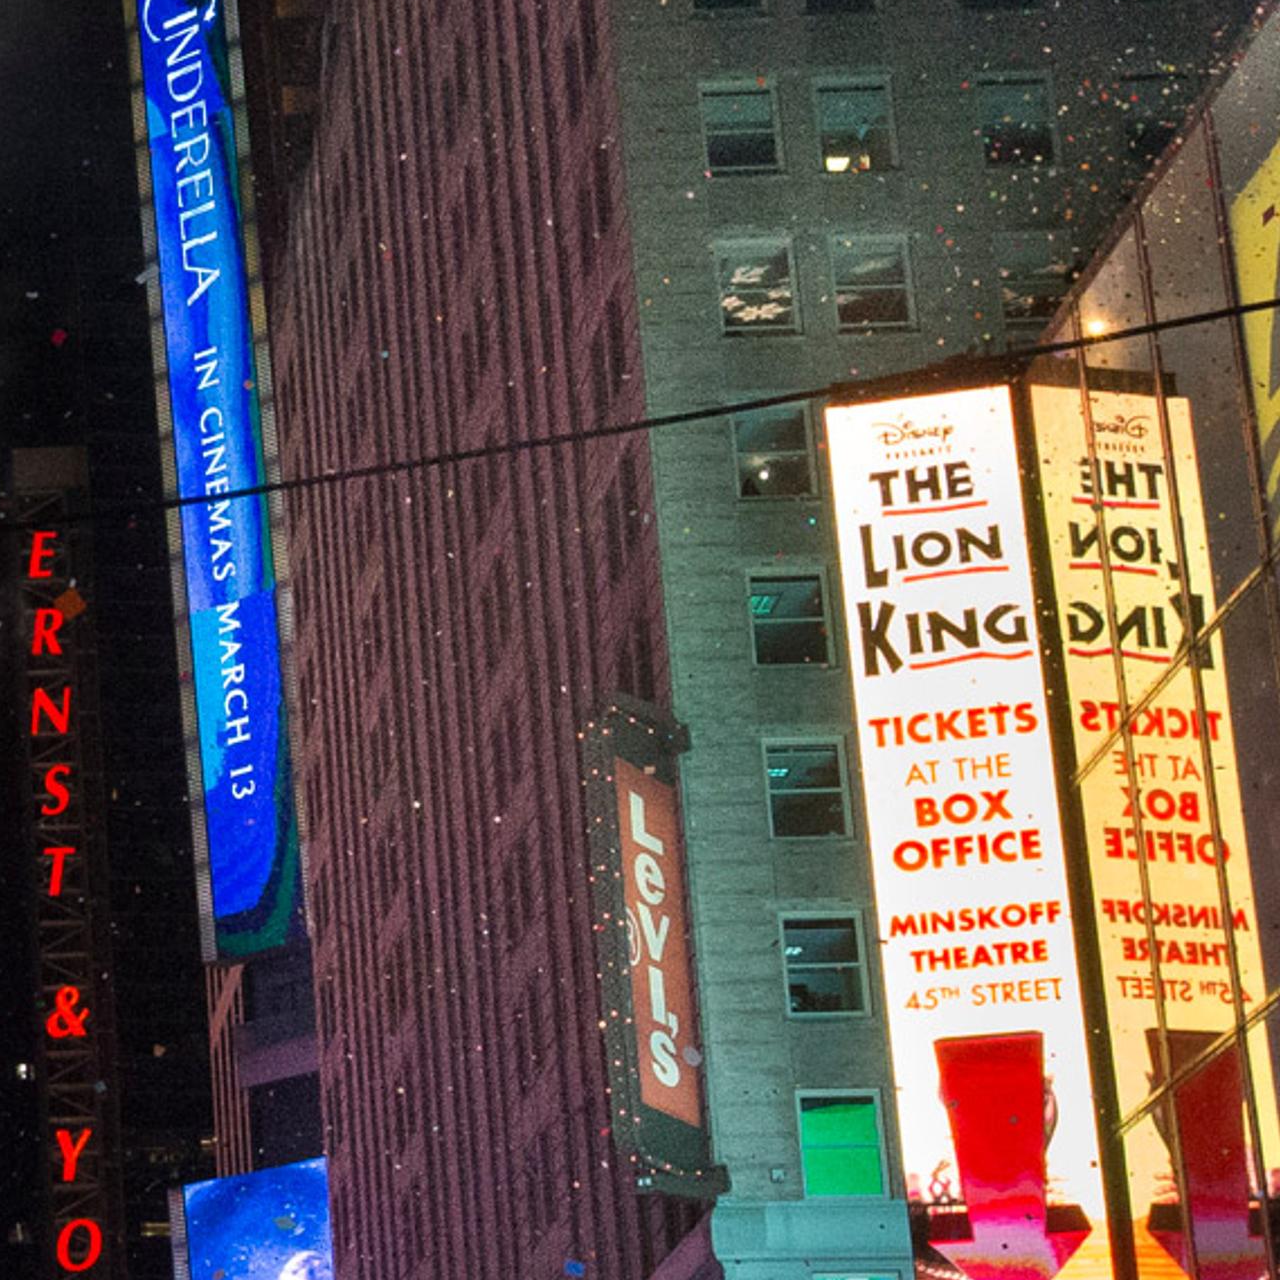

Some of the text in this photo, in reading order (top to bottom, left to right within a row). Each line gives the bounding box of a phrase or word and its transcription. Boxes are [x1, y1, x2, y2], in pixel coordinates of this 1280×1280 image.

[193, 347, 220, 390] IN
[198, 405, 236, 584] CINEMAS
[869, 461, 974, 508] THE
[859, 524, 1003, 588] LION
[856, 601, 1030, 677] KING
[216, 601, 252, 745] MARCH
[26, 530, 76, 898] ERNST
[868, 702, 1038, 748] TICKETS
[229, 763, 256, 801] 13
[905, 753, 1012, 787] AT THE
[913, 788, 1012, 829] BOX
[893, 829, 1042, 873] OFFICE
[889, 900, 1062, 938] MINSKOFF
[910, 940, 1049, 974] THEATRE
[46, 983, 92, 1040] &
[904, 977, 1063, 1011] 45TH STREET
